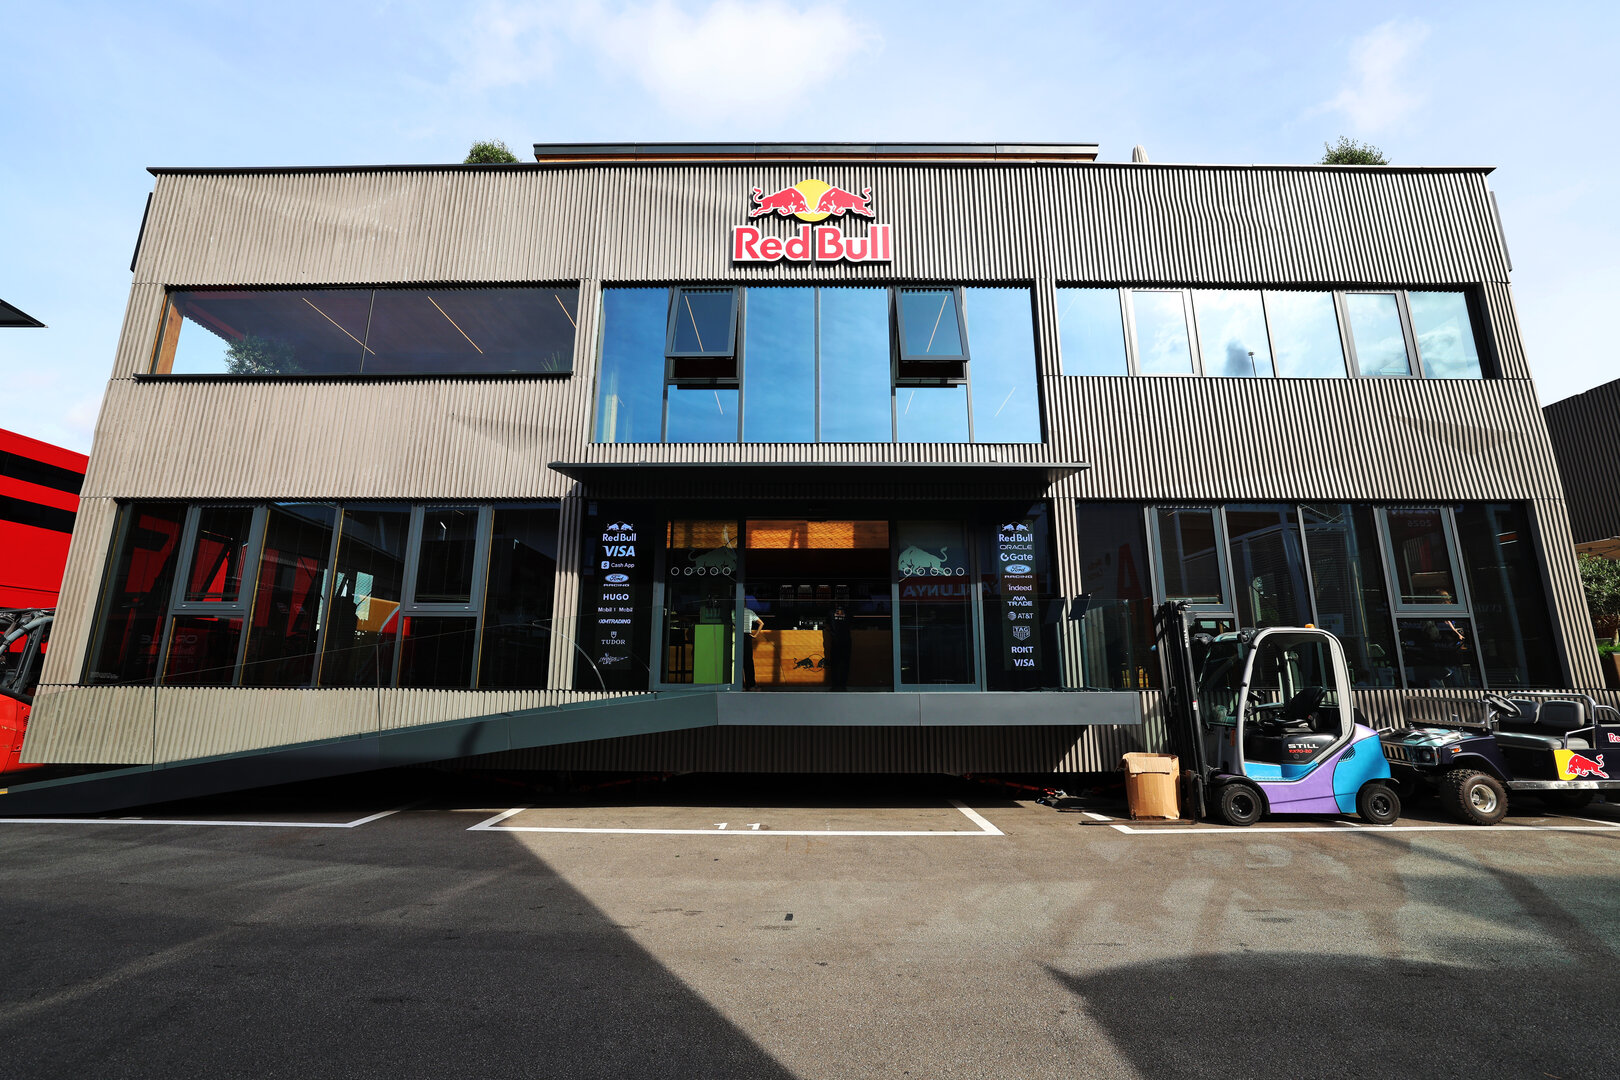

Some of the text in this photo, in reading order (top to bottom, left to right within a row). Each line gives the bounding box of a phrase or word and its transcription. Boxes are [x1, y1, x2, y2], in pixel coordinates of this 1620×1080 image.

[734, 225, 891, 261] Red Bull
[602, 533, 637, 542] Red Bull
[998, 533, 1033, 542] Red Bull
[602, 545, 636, 557] VISA
[1009, 553, 1033, 561] Gate
[1007, 583, 1033, 592] indeed
[602, 593, 630, 601] HUGO
[1017, 612, 1034, 620] AT&T
[1011, 646, 1034, 654] ROKT
[1012, 658, 1035, 667] VISA
